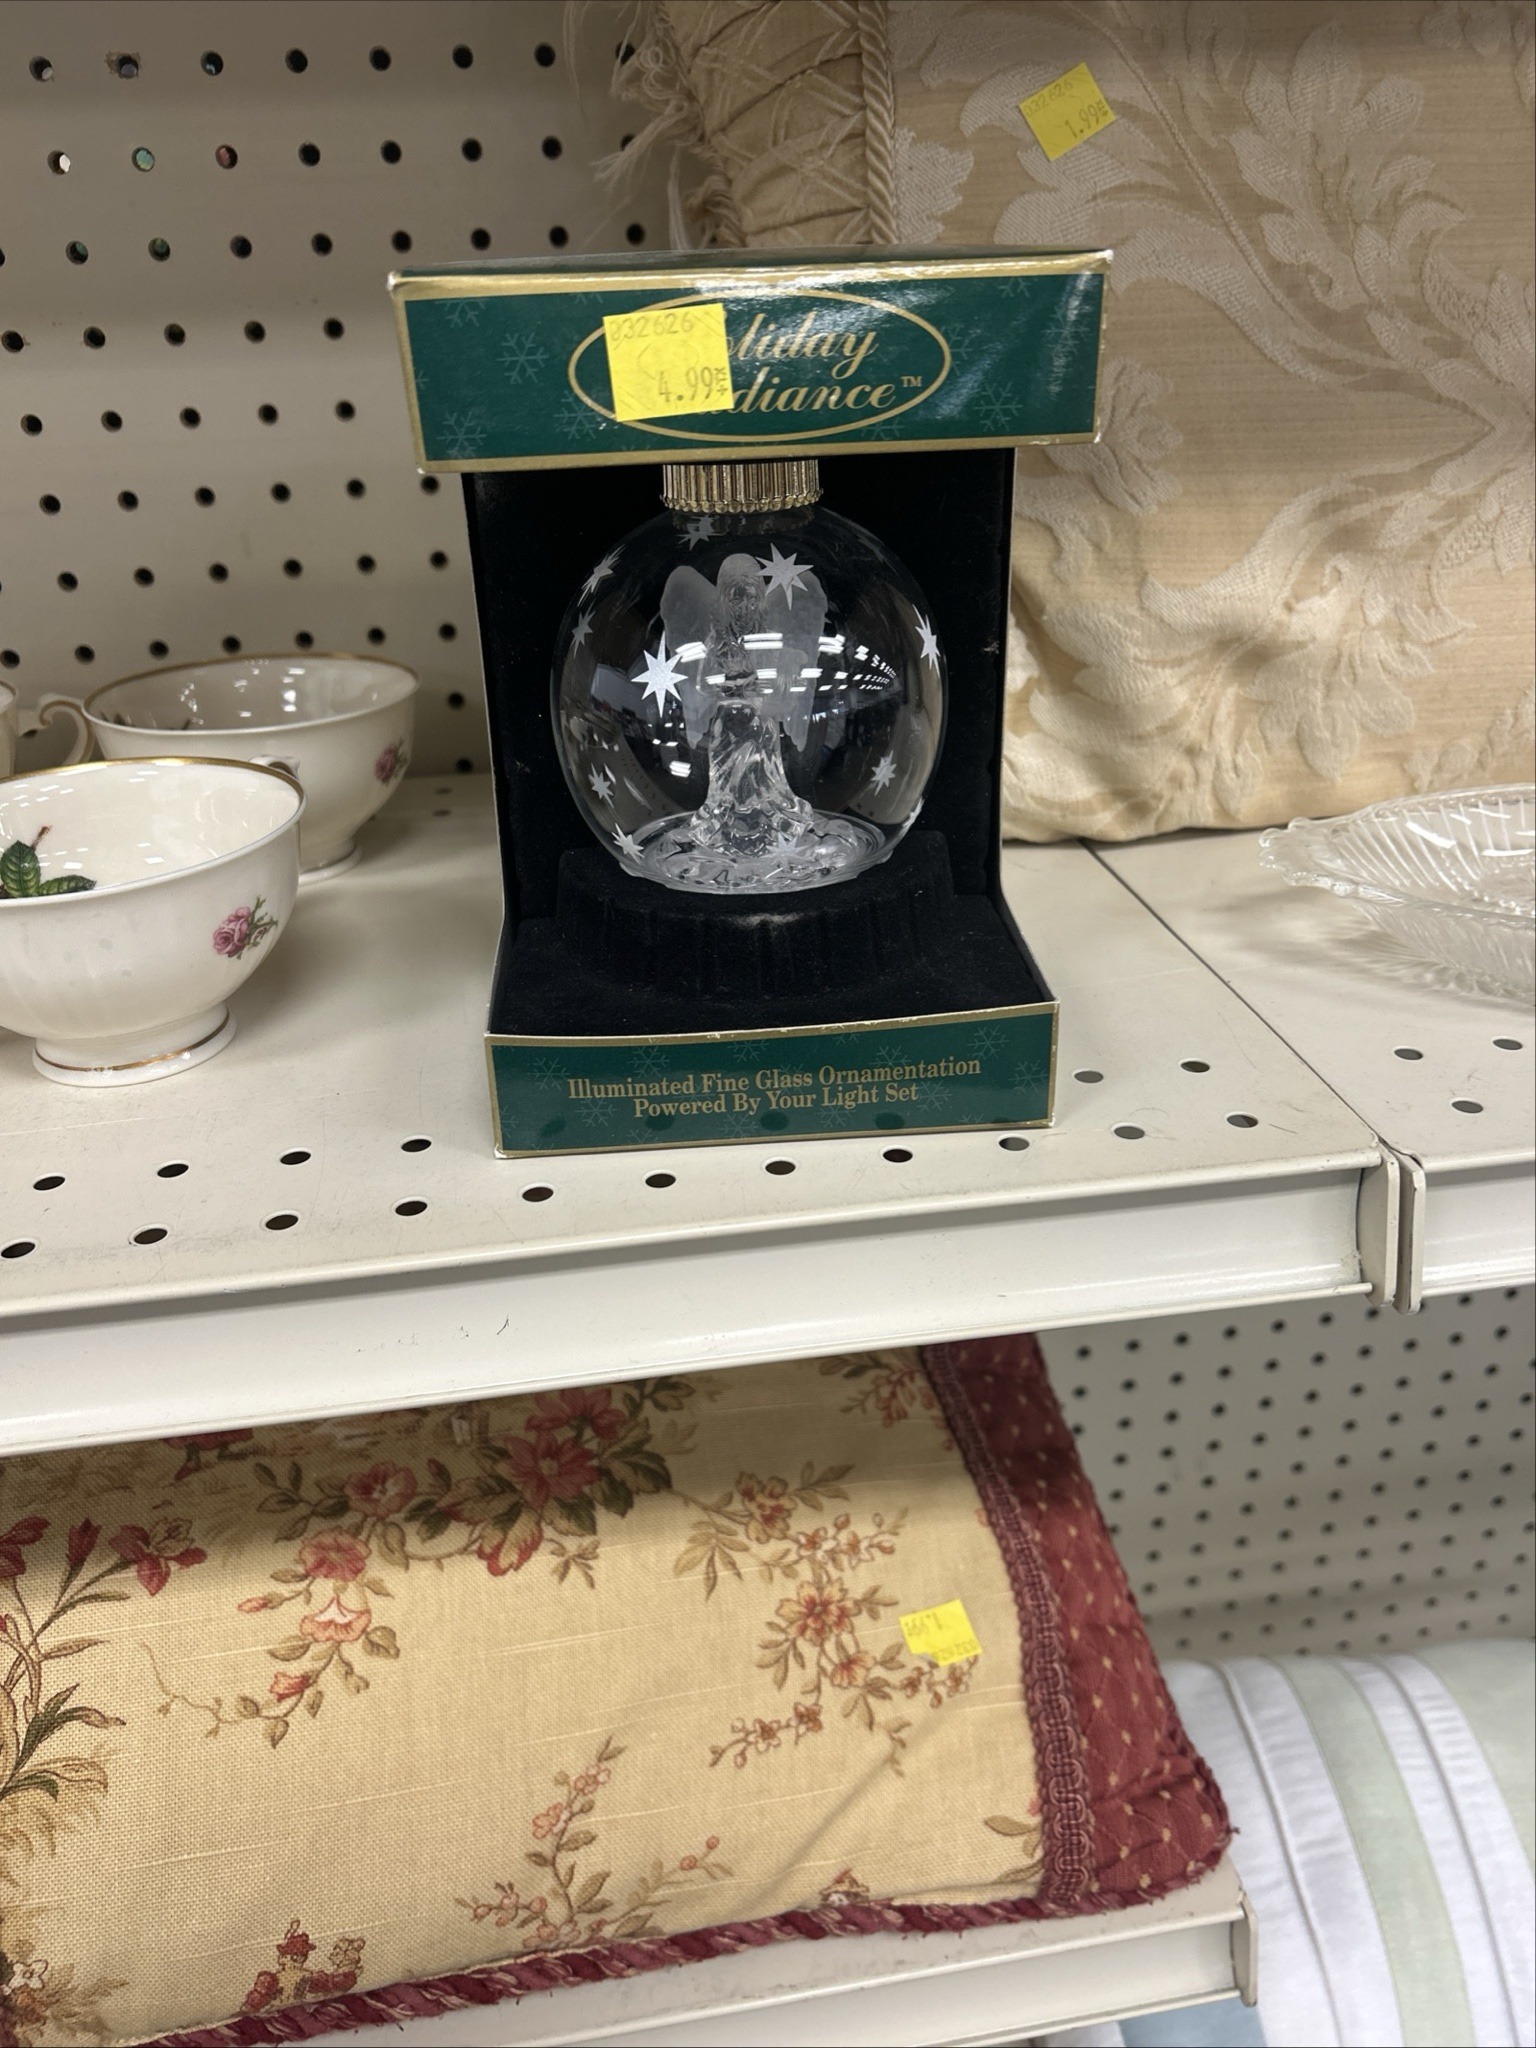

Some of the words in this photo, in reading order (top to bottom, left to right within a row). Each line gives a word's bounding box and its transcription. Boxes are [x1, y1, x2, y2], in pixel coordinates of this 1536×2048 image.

[1065, 104, 1099, 138] 1.99
[609, 311, 695, 342] 032626
[728, 311, 880, 380] liday
[659, 366, 714, 403] 4.99
[712, 366, 896, 415] diance
[568, 1074, 695, 1099] Illuminated
[701, 1073, 750, 1094] Fine
[755, 1069, 813, 1090] Glass
[819, 1056, 981, 1086] Ornamentation
[634, 1095, 727, 1118] Powered
[733, 1092, 761, 1115] By
[765, 1090, 817, 1110] Your
[821, 1084, 880, 1110] Light
[885, 1082, 919, 1103] Set
